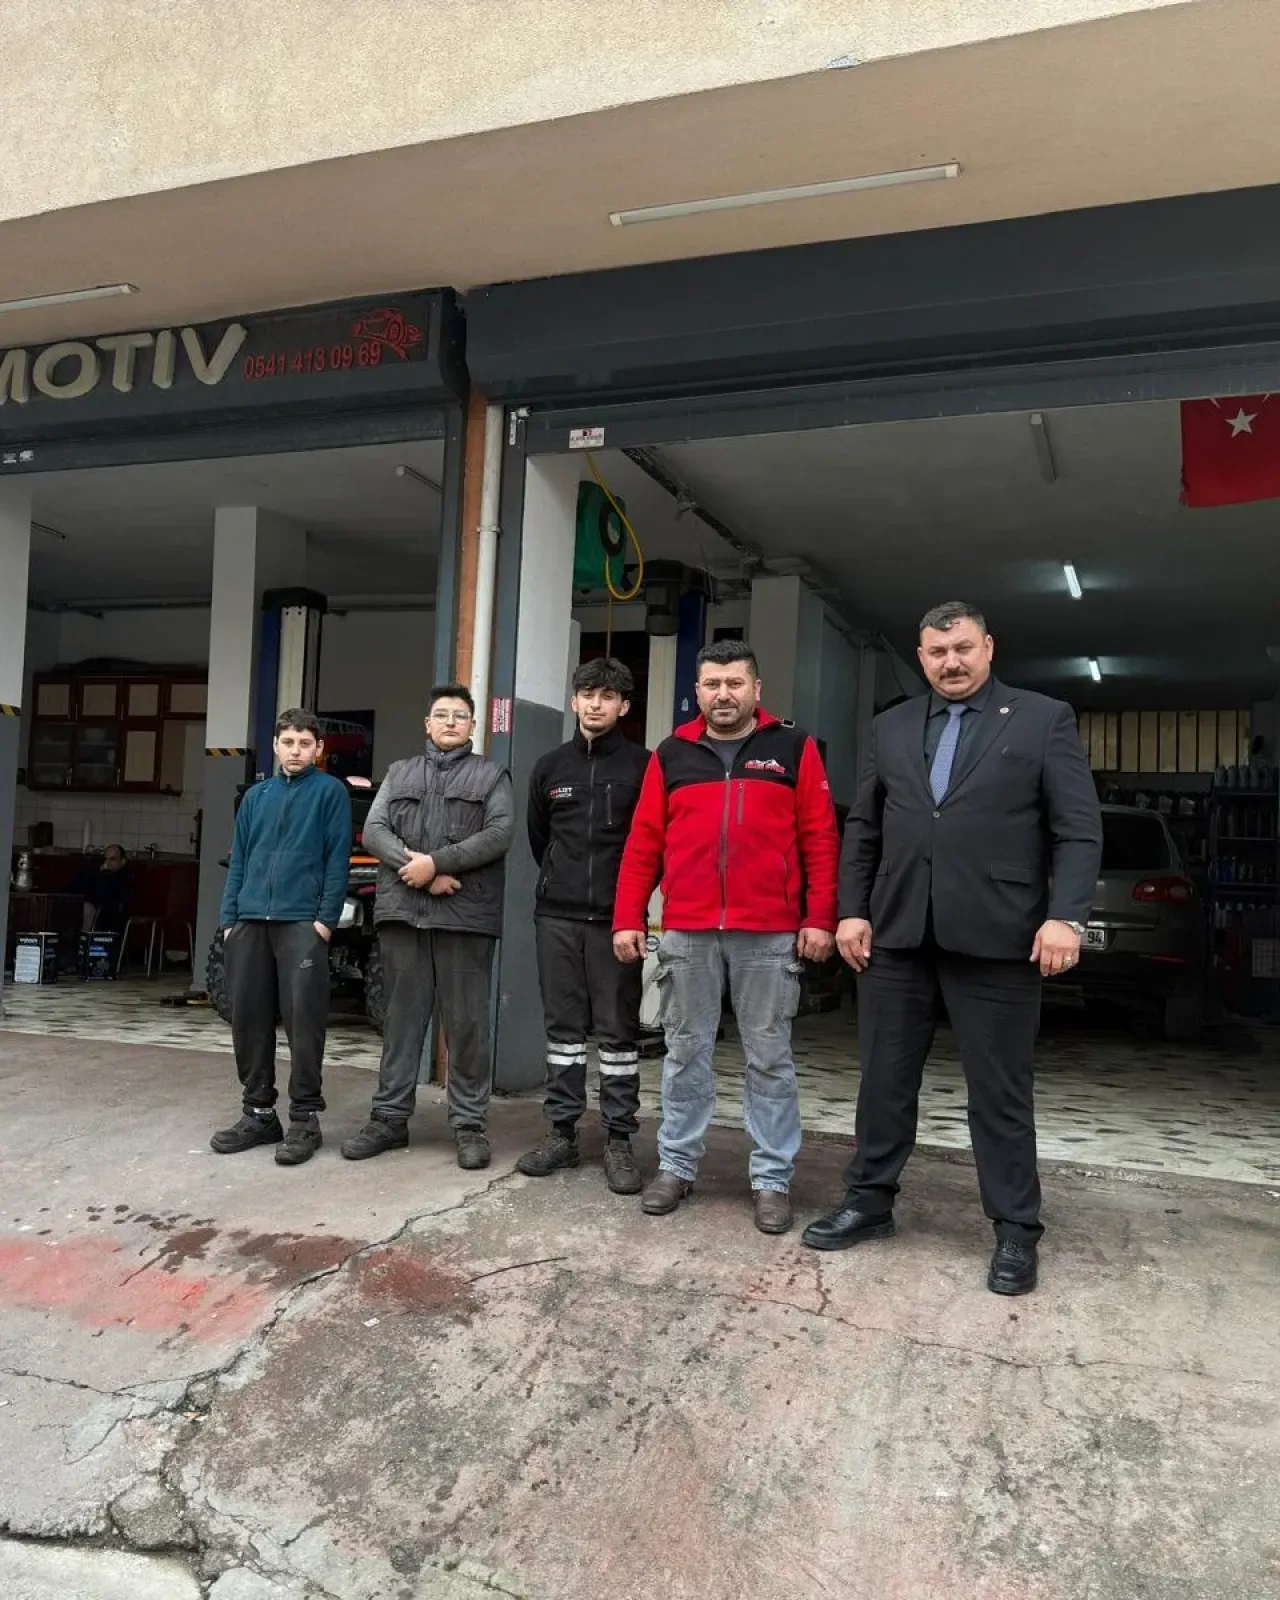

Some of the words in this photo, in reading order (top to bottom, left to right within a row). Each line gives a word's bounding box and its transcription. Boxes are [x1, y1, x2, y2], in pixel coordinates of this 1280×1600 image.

[243, 352, 286, 380] 0541
[292, 346, 326, 374] 413
[330, 344, 354, 370] 09
[358, 340, 383, 367] 69
[1087, 931, 1103, 945] 94
